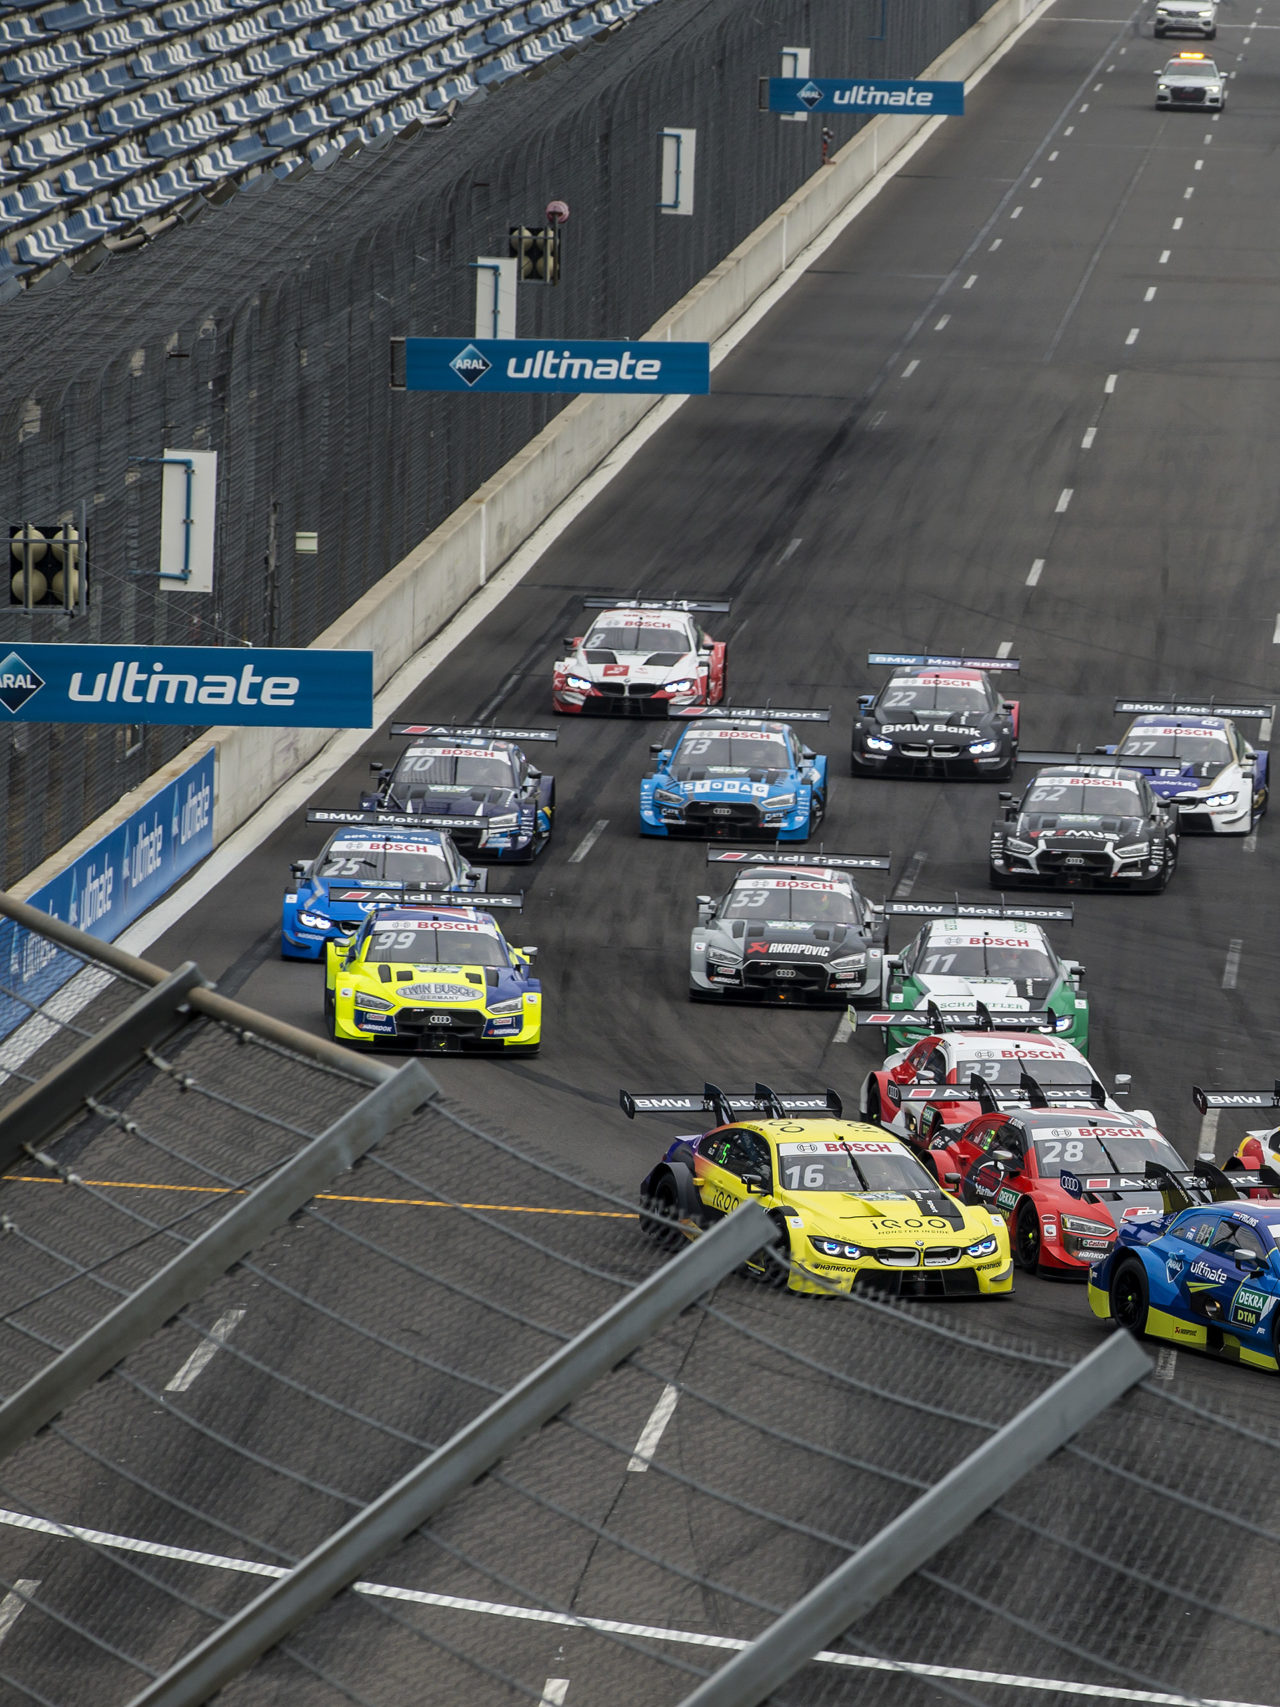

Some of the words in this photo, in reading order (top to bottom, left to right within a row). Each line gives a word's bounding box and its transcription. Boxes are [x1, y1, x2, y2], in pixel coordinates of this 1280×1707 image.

[833, 85, 934, 106] ultimate
[455, 359, 487, 370] ARAL
[506, 350, 662, 380] ultimate
[586, 633, 606, 648] 8
[68, 661, 300, 706] ultimate
[922, 679, 971, 687] BOSCH
[884, 692, 918, 707] 22
[1121, 703, 1165, 711] BMW
[1176, 705, 1265, 716] Motrsport
[719, 731, 771, 739] BOSCH
[881, 724, 930, 734] BMW
[933, 724, 981, 737] Bank
[1162, 728, 1213, 737] BOSCH
[441, 749, 495, 758] BOSCH
[684, 740, 713, 755] 13
[1124, 741, 1157, 755] 27
[402, 757, 436, 772] 10
[683, 781, 768, 796] STOBAG
[1069, 778, 1123, 787] BOSCH
[1028, 787, 1067, 802] 62
[181, 772, 210, 846] ultimate
[314, 812, 365, 821] BMW
[378, 815, 481, 826] Motrsport
[132, 811, 163, 888] ultimate
[369, 842, 428, 853] BOSCH
[323, 857, 366, 876] 25
[775, 880, 834, 890] BOSCH
[731, 891, 770, 908] 53
[892, 904, 943, 913] BMW
[417, 921, 479, 932] BOSCH
[375, 932, 417, 950] 99
[969, 937, 1030, 947] BOSCH
[924, 953, 958, 973] 11
[401, 984, 432, 996] TWIN
[434, 983, 477, 997] BUSCH
[940, 1001, 1024, 1010] SCHAFFLER
[1001, 1050, 1065, 1059] BOSCH
[958, 1062, 1002, 1082] 33
[634, 1099, 691, 1108] BMW
[1206, 1095, 1263, 1104] BMW
[1078, 1127, 1145, 1138] BOSCH
[825, 1142, 892, 1154] BOSCH
[1042, 1141, 1084, 1165] 28
[784, 1164, 825, 1190] 16
[870, 1219, 947, 1231] iQOO
[1190, 1261, 1228, 1284] ultimate
[1239, 1291, 1263, 1310] DEKRA
[1237, 1310, 1256, 1325] DTM
